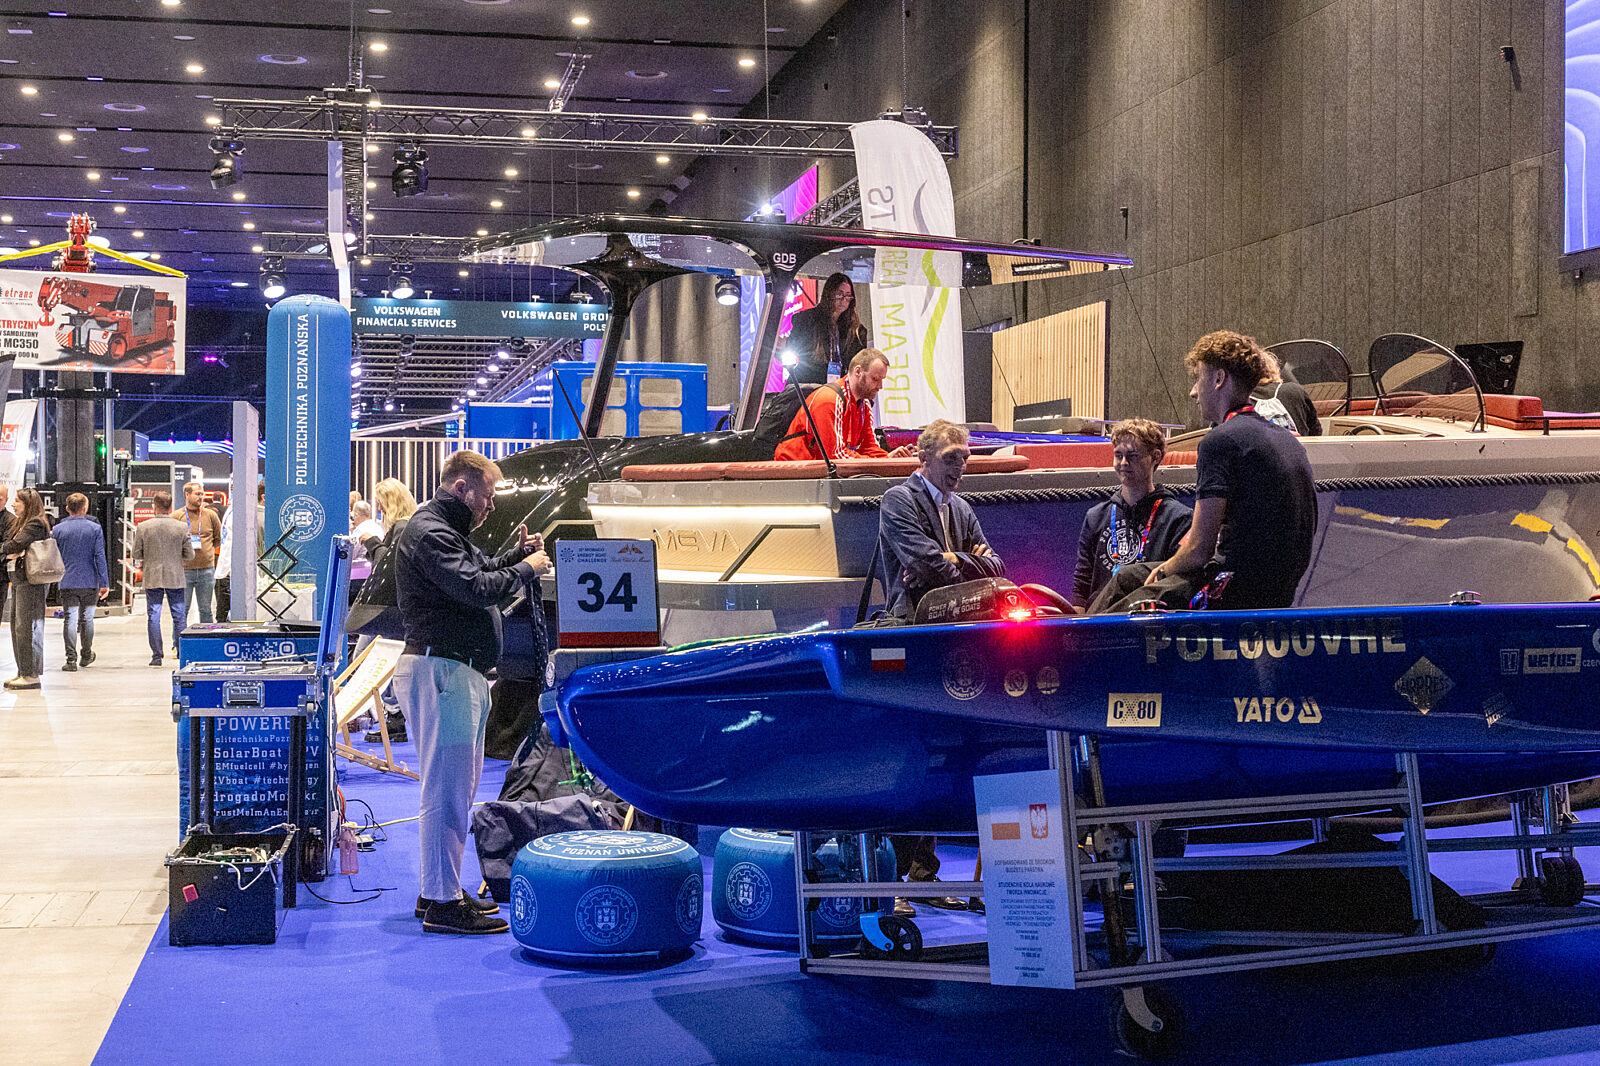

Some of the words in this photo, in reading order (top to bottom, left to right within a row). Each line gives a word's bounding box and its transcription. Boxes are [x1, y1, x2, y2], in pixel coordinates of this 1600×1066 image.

[773, 252, 797, 264] GDB
[373, 305, 441, 316] VOLKSWAGEN
[501, 310, 578, 321] VOLKSWAGEN
[582, 312, 608, 321] GRO
[0, 319, 39, 330] TRYCZNY
[356, 317, 409, 327] FINANCIAL
[411, 318, 457, 328] SERVICES
[583, 323, 607, 331] POLS
[4, 339, 39, 349] MC350
[295, 313, 309, 390] POZNAŃSKA
[295, 394, 308, 485] POLITECHNIKA
[577, 571, 638, 613] 34
[1233, 697, 1295, 723] YATO
